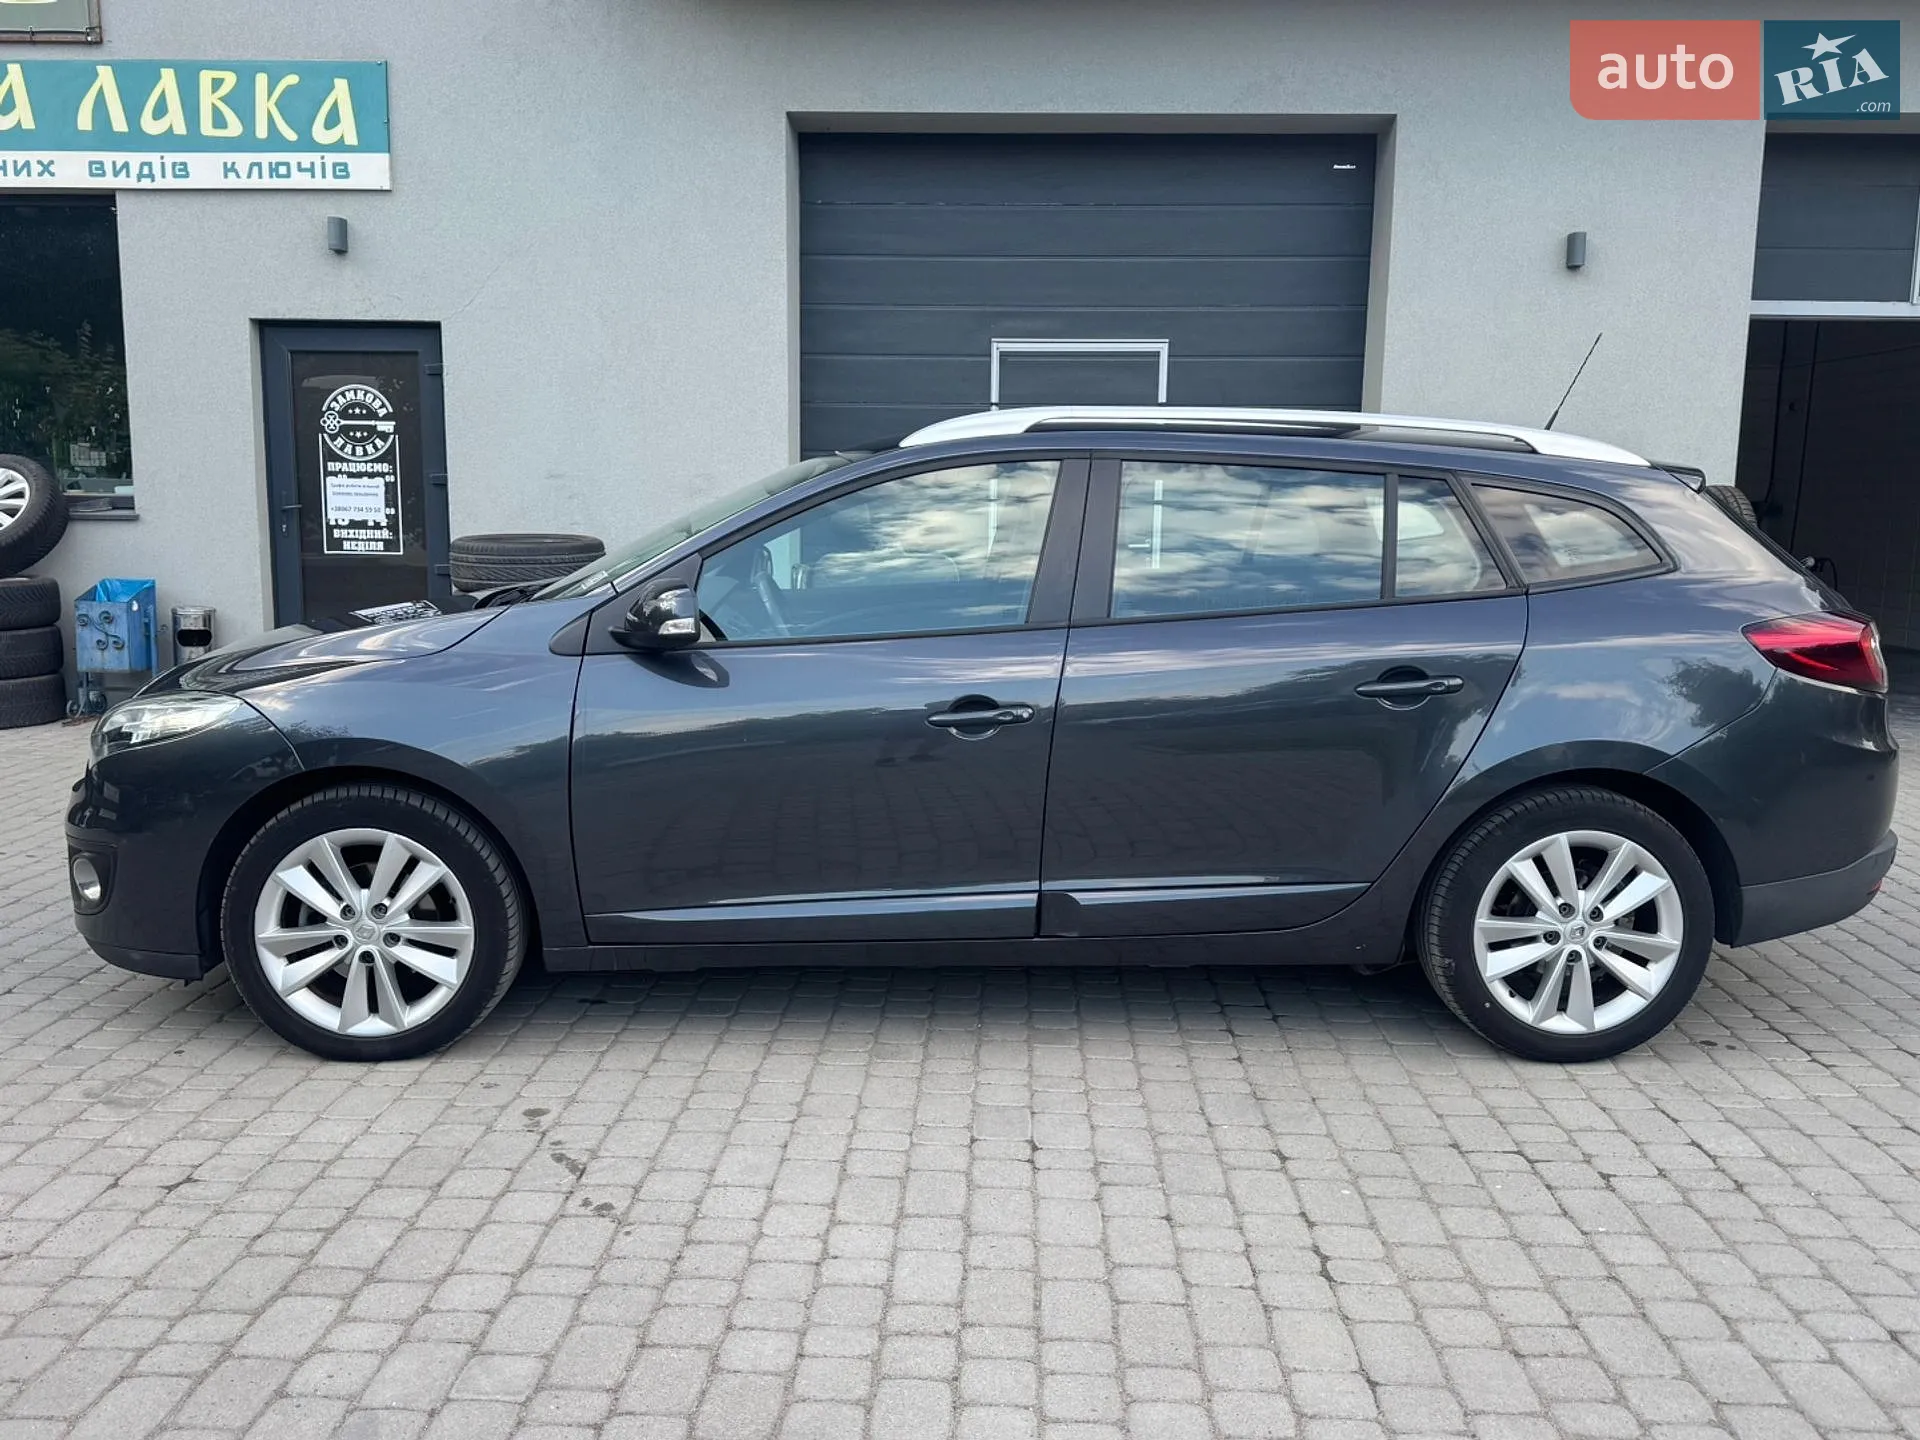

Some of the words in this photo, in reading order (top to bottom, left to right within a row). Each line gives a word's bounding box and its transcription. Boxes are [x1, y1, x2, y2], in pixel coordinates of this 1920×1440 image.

[76, 65, 359, 146] ЛАВКА
[330, 389, 388, 418] ЗАМКОВА
[333, 436, 385, 456] ЛАВКА
